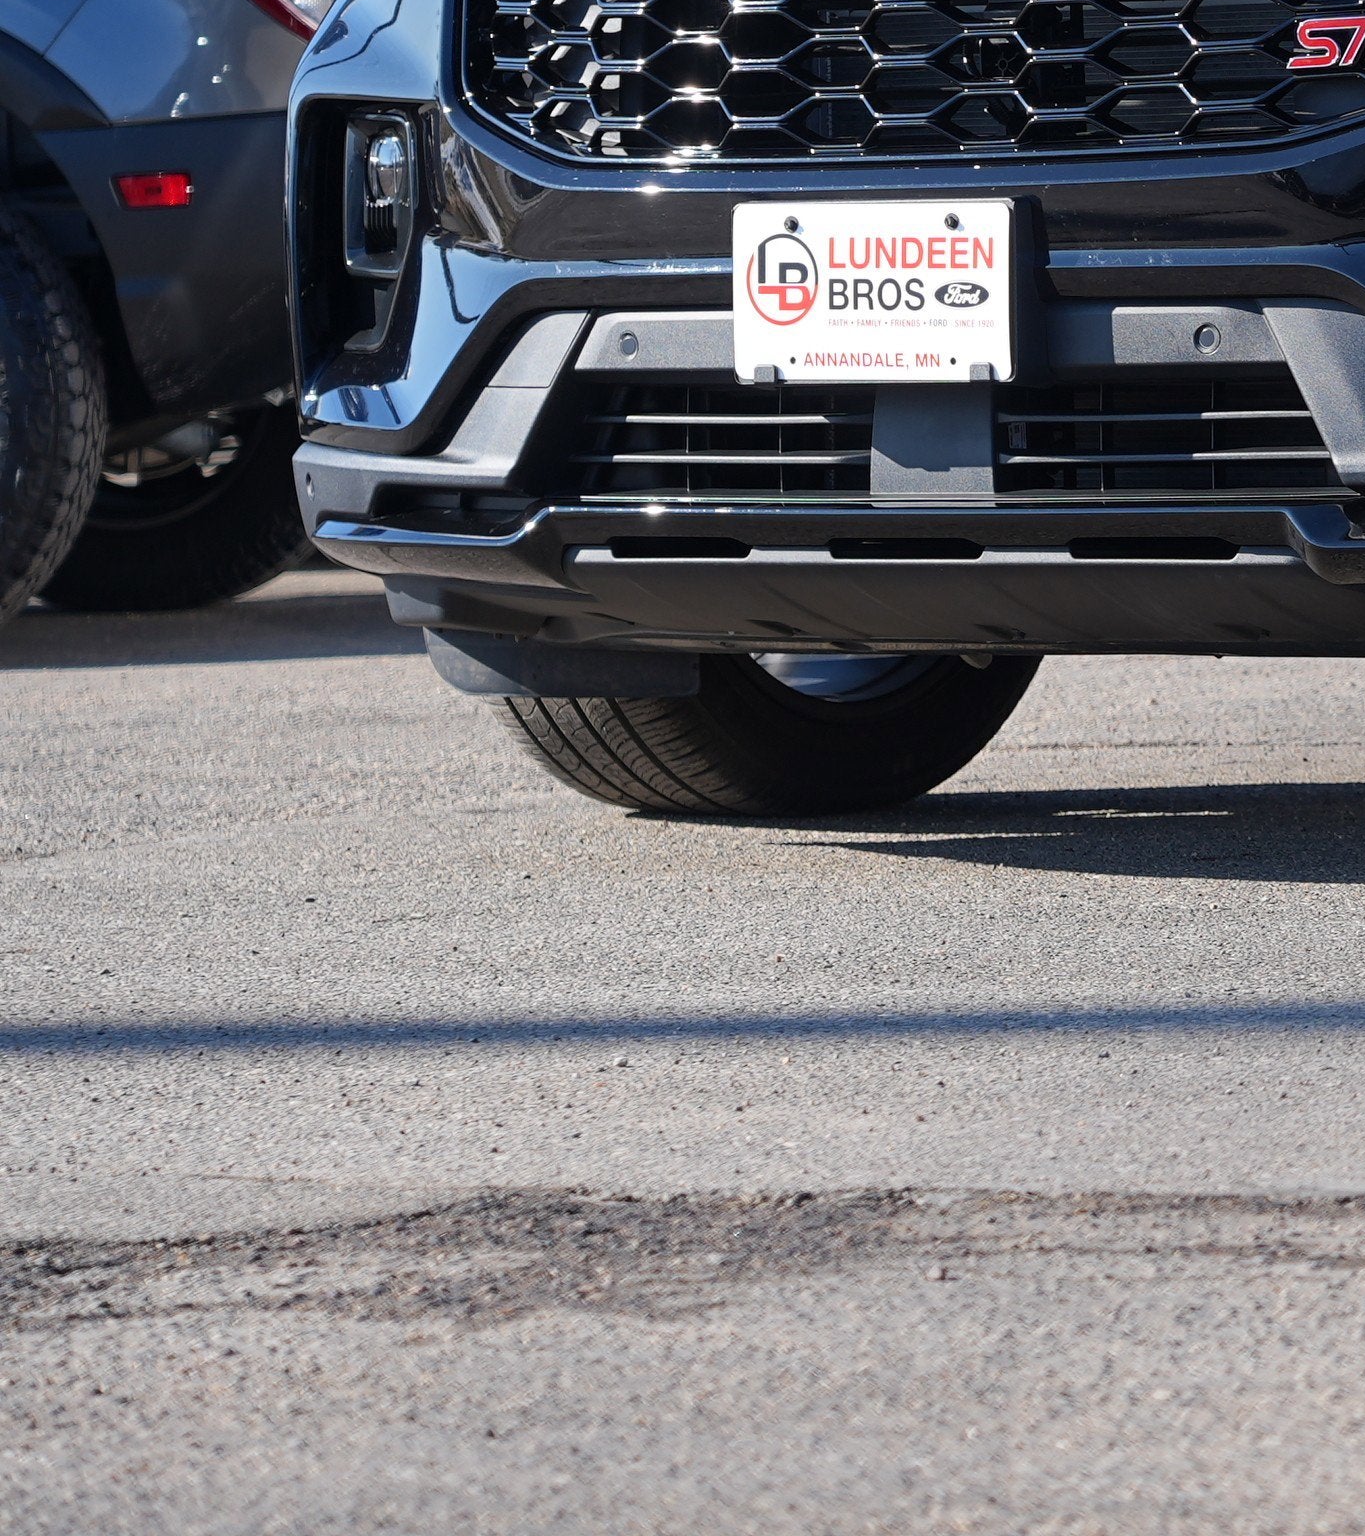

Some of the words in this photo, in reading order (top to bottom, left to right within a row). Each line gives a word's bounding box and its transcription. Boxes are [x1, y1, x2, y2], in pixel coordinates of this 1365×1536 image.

[828, 237, 994, 269] LUNDEEN
[828, 277, 926, 311] BROS
[828, 318, 849, 327] FAITH
[856, 318, 882, 327] FAMILY
[890, 318, 921, 327] FRIENDS
[928, 318, 948, 327] FORD
[954, 319, 975, 328] SINCE
[978, 319, 995, 328] 1920
[803, 352, 910, 370] ANNANDALE,
[915, 352, 941, 368] MN
